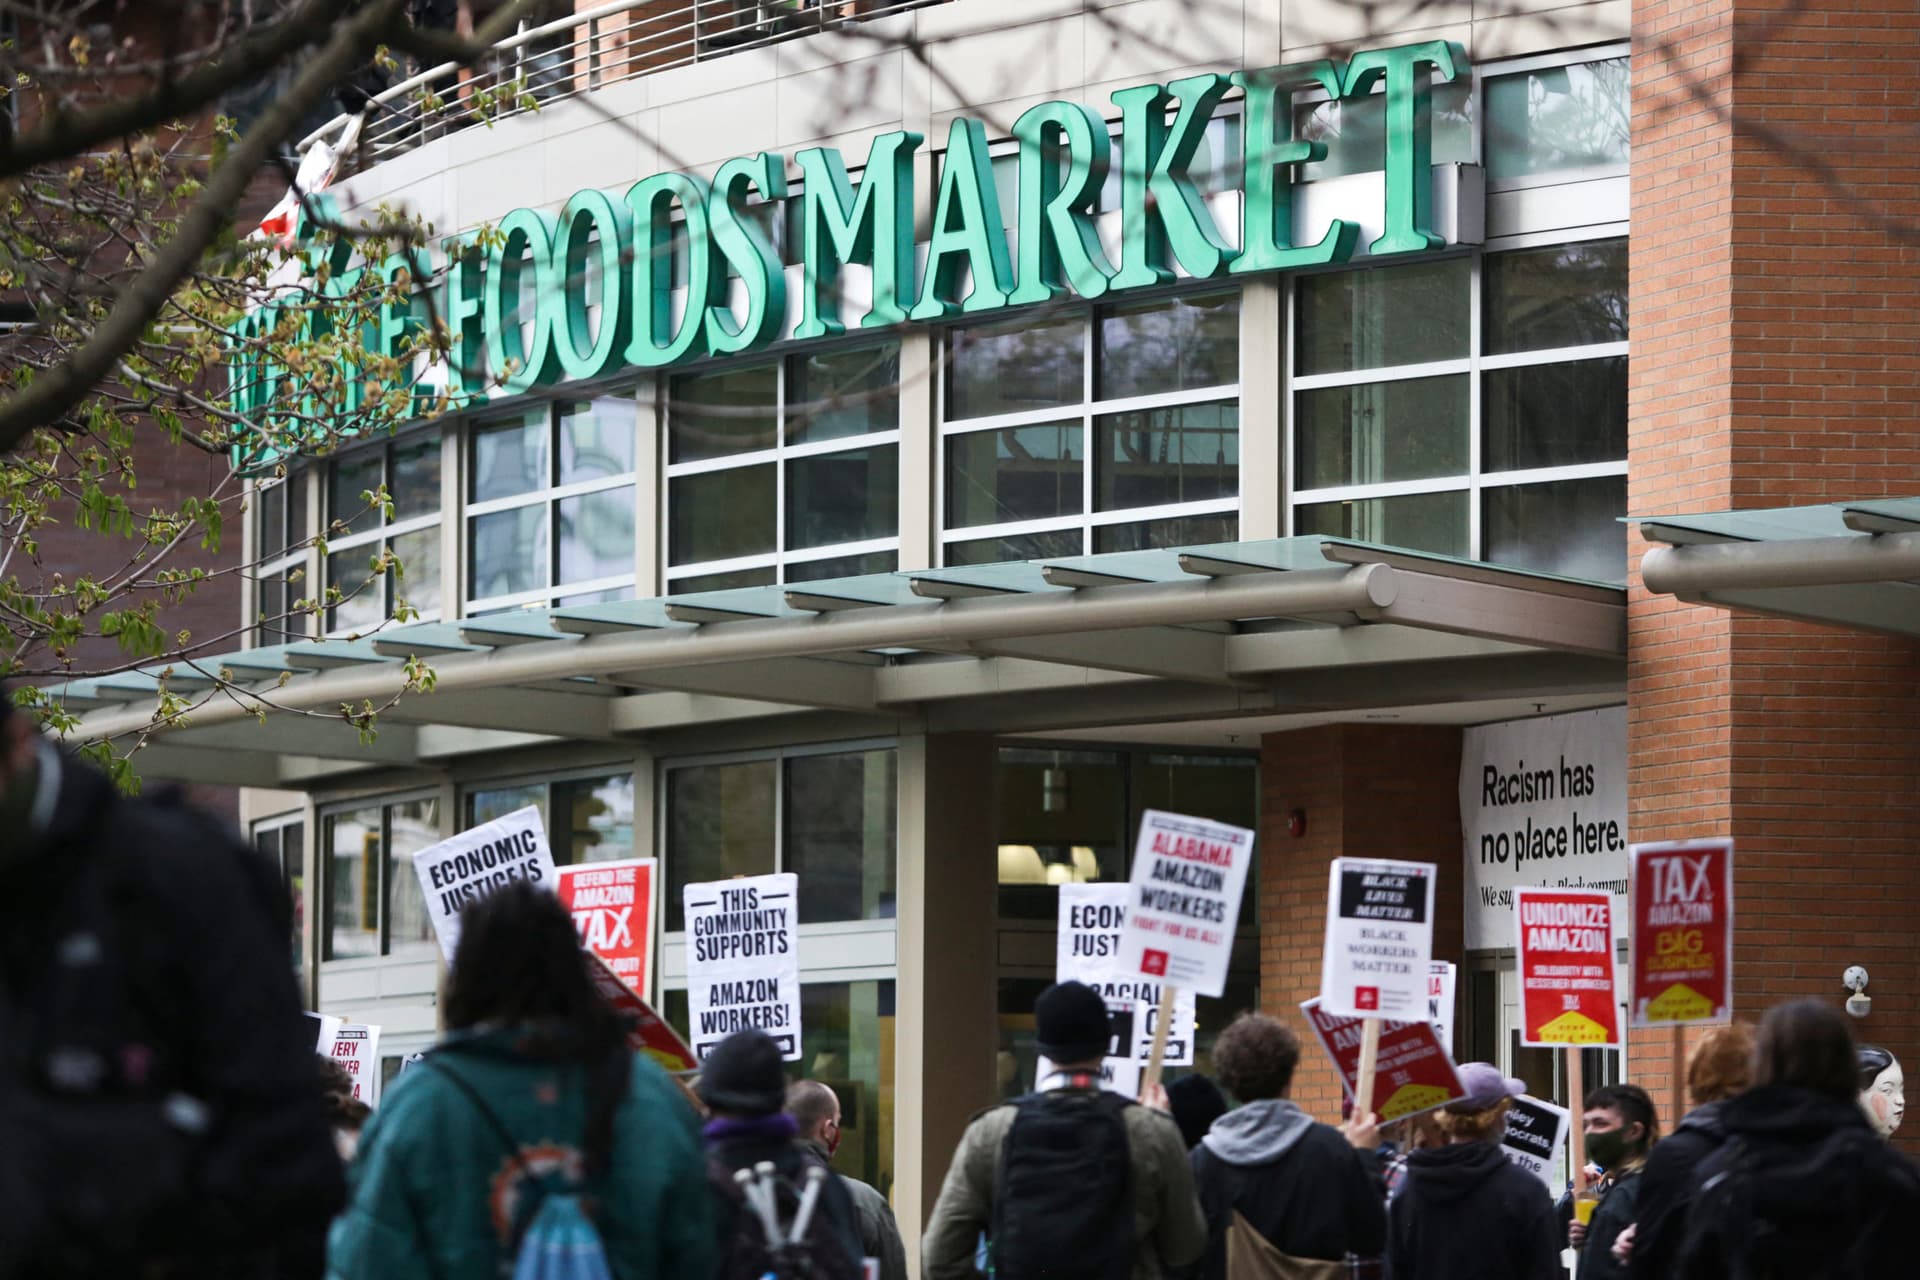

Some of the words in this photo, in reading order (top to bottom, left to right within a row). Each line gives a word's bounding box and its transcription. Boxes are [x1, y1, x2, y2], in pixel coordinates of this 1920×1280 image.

[440, 152, 785, 412] FOODS
[795, 39, 1471, 338] MARKET
[1482, 760, 1555, 807] Racism
[1560, 755, 1594, 798] has
[1152, 832, 1233, 868] ALABAMA
[1481, 832, 1510, 864] no
[1514, 817, 1567, 872] place
[1573, 811, 1625, 855] here.
[429, 829, 537, 889] ECONOMIC
[1151, 859, 1224, 893] AMAZON
[1361, 875, 1409, 888] BLACK
[1648, 854, 1714, 904] TAX
[572, 885, 634, 909] AMAZON
[721, 888, 758, 912] THIS
[1140, 886, 1227, 923] WORKERS
[1481, 885, 1497, 907] We
[694, 908, 787, 936] COMMUNITY
[1355, 904, 1414, 920] MATTER
[1522, 902, 1608, 928] UNIONIZE
[1648, 903, 1713, 926] AMAZON
[572, 907, 634, 950] TAX
[1360, 927, 1406, 942] BLACK
[1527, 928, 1606, 953] AMAZON
[1655, 930, 1703, 955] BIG
[696, 930, 788, 961] SUPPORTS
[1348, 943, 1418, 959] WORKERS
[1352, 960, 1412, 974] MATTER
[710, 978, 778, 1007] AMAZON
[701, 1004, 789, 1034] WORKERS!
